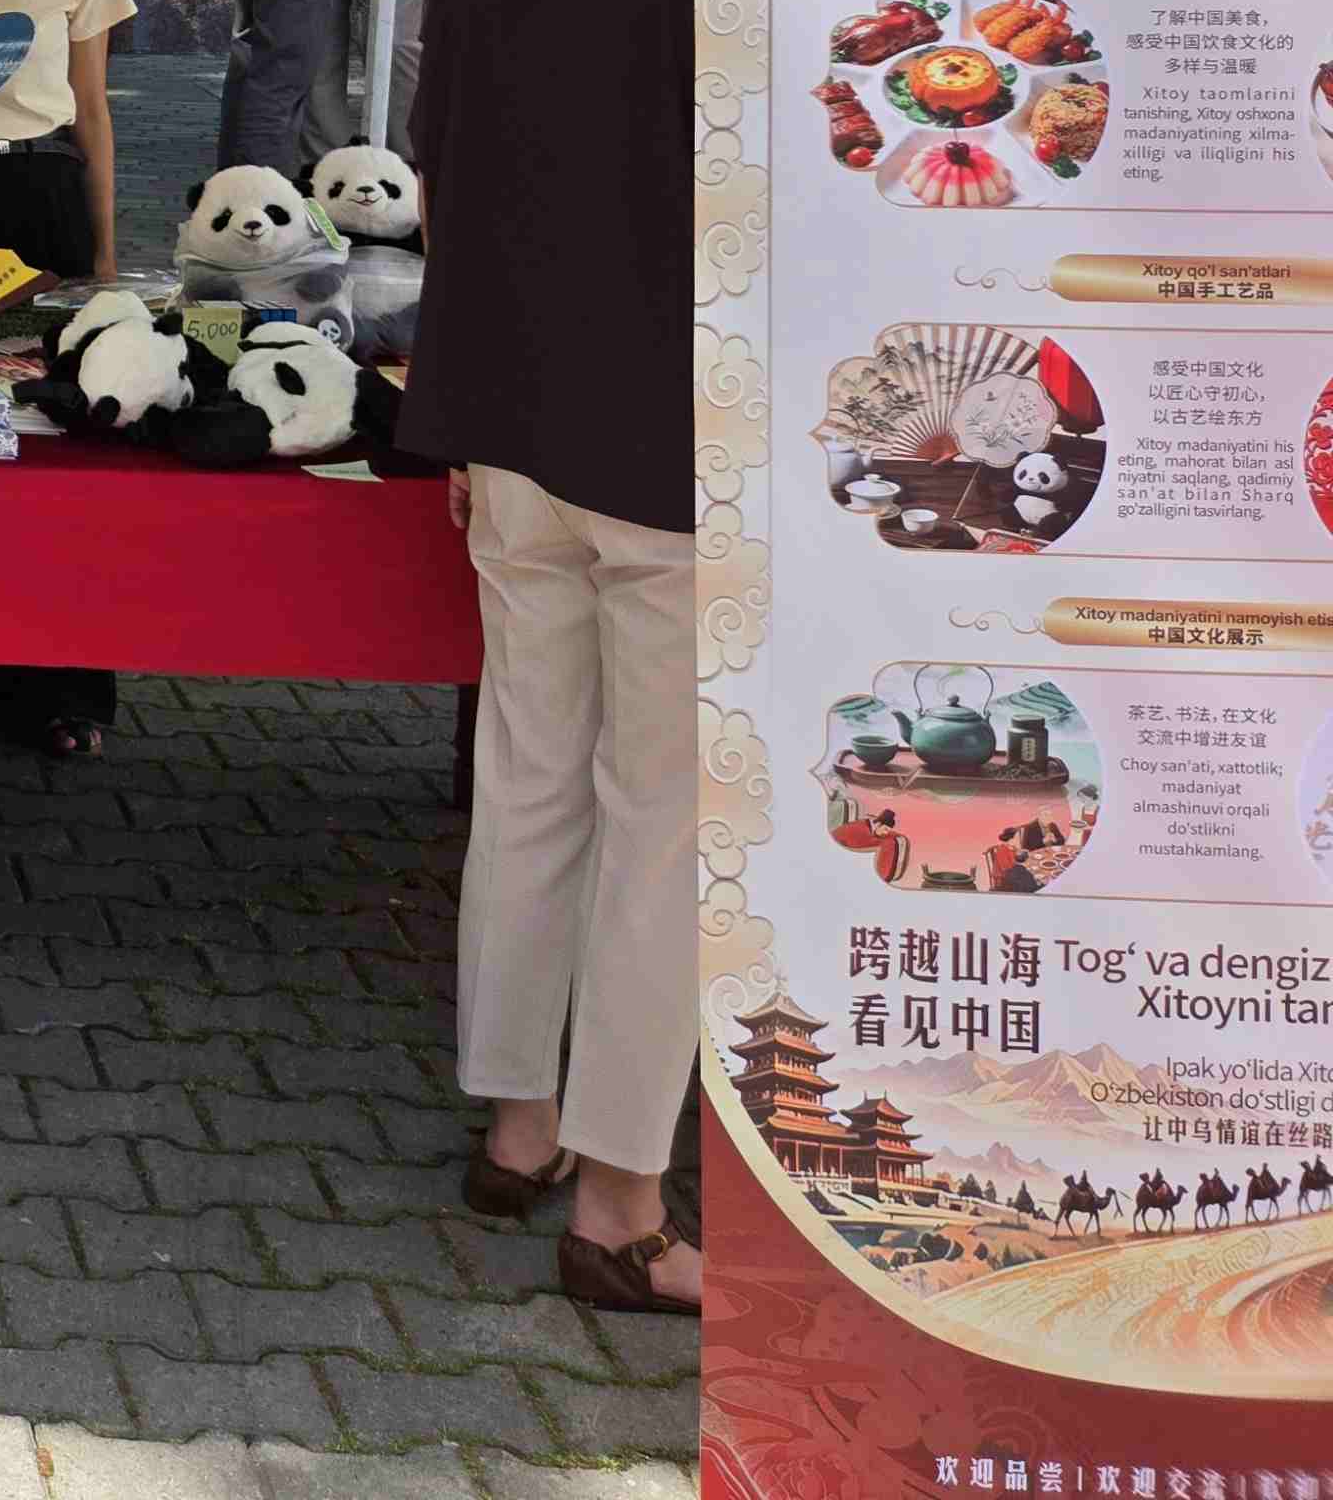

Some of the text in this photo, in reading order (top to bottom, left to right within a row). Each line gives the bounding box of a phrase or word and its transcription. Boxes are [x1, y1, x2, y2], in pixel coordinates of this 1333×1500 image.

[1126, 34, 1294, 50] 感受中国饮食文化的
[1165, 58, 1258, 74] 多样与温暖
[1142, 86, 1295, 102] Xitoy taomlarini
[1197, 108, 1231, 123] Xitoy
[1236, 107, 1295, 120] oshxona
[1124, 127, 1295, 143] madaniyatining xilma-
[1123, 147, 1165, 162] xilligi
[1174, 150, 1191, 159] va
[1272, 148, 1295, 160] his
[1143, 263, 1183, 279] Xitoy
[1219, 264, 1291, 278] san'atlari
[1158, 281, 1274, 299] 中国手工艺品
[1153, 360, 1264, 378] 感受中国文化
[1154, 409, 1262, 426] 以古艺绘东方
[1137, 437, 1294, 455] Xitoy madaniyatini his
[1165, 455, 1225, 468] mahorat
[1233, 456, 1267, 469] bilan
[1274, 456, 1294, 469] asl
[1118, 471, 1165, 485] niyatni
[1237, 473, 1294, 488] qadimiy
[1185, 488, 1231, 500] bilan
[1242, 489, 1294, 505] Sharq
[1075, 607, 1116, 623] Xitoy
[1120, 608, 1221, 625] madaniyatini
[1226, 612, 1303, 628] namoyish
[1148, 626, 1264, 645] 中国文化展示
[1137, 730, 1267, 748] 交流中增进友谊
[1120, 758, 1158, 774] Choy
[1162, 780, 1242, 797] madaniyat
[1133, 800, 1270, 819] almashinuvi orqali
[848, 926, 1042, 988] 跨越山海
[1145, 951, 1190, 977] va
[1200, 944, 1331, 991] dengiz
[1137, 985, 1272, 1030] Xitoyni
[849, 994, 1042, 1054] 看见中国
[1166, 1056, 1216, 1081] Ipak
[1143, 1116, 1333, 1149] 让中乌情谊在丝路
[935, 1456, 1063, 1493] 欢迎品尝
